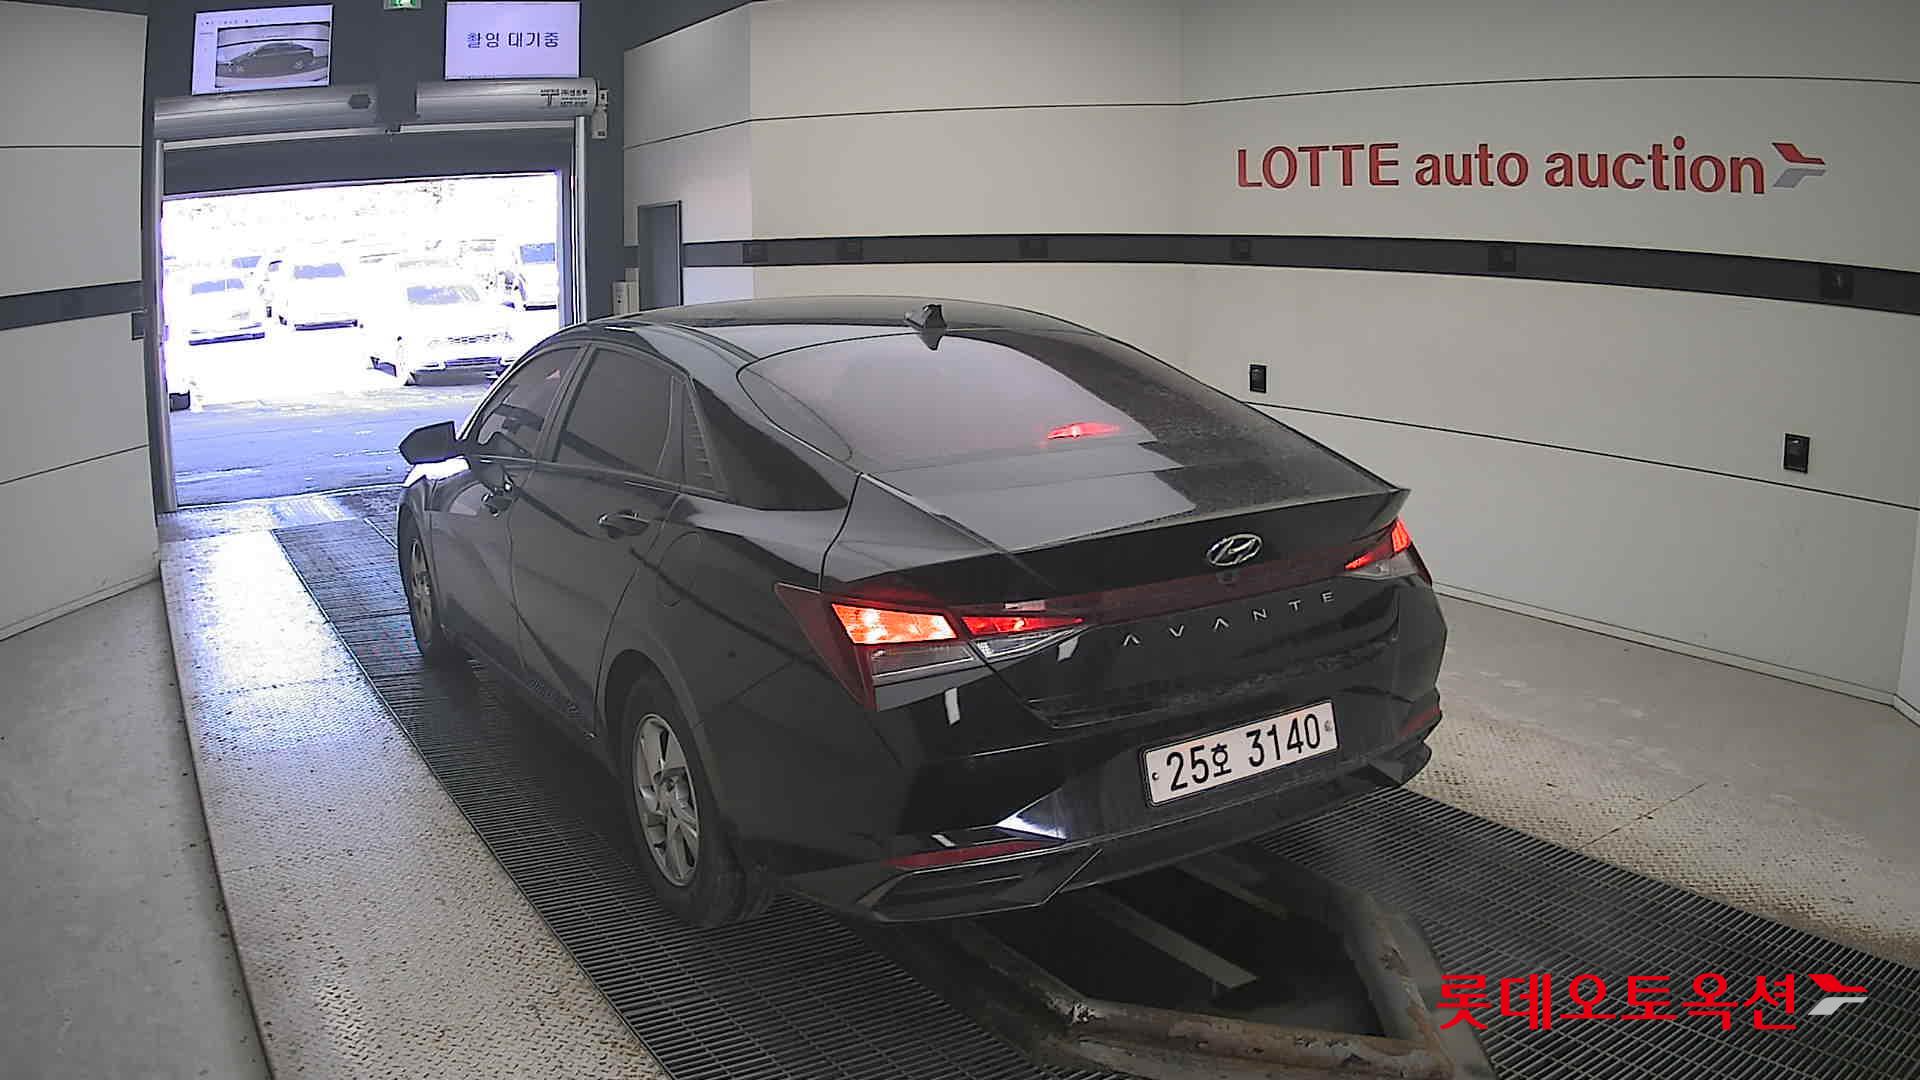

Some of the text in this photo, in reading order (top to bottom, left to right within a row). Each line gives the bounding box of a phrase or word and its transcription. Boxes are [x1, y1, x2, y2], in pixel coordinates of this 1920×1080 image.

[508, 32, 560, 48] 대기중
[1237, 135, 1765, 194] LOTTE auto auction
[1122, 591, 1335, 646] AVANTE
[1166, 713, 1321, 791] 25호 3140
